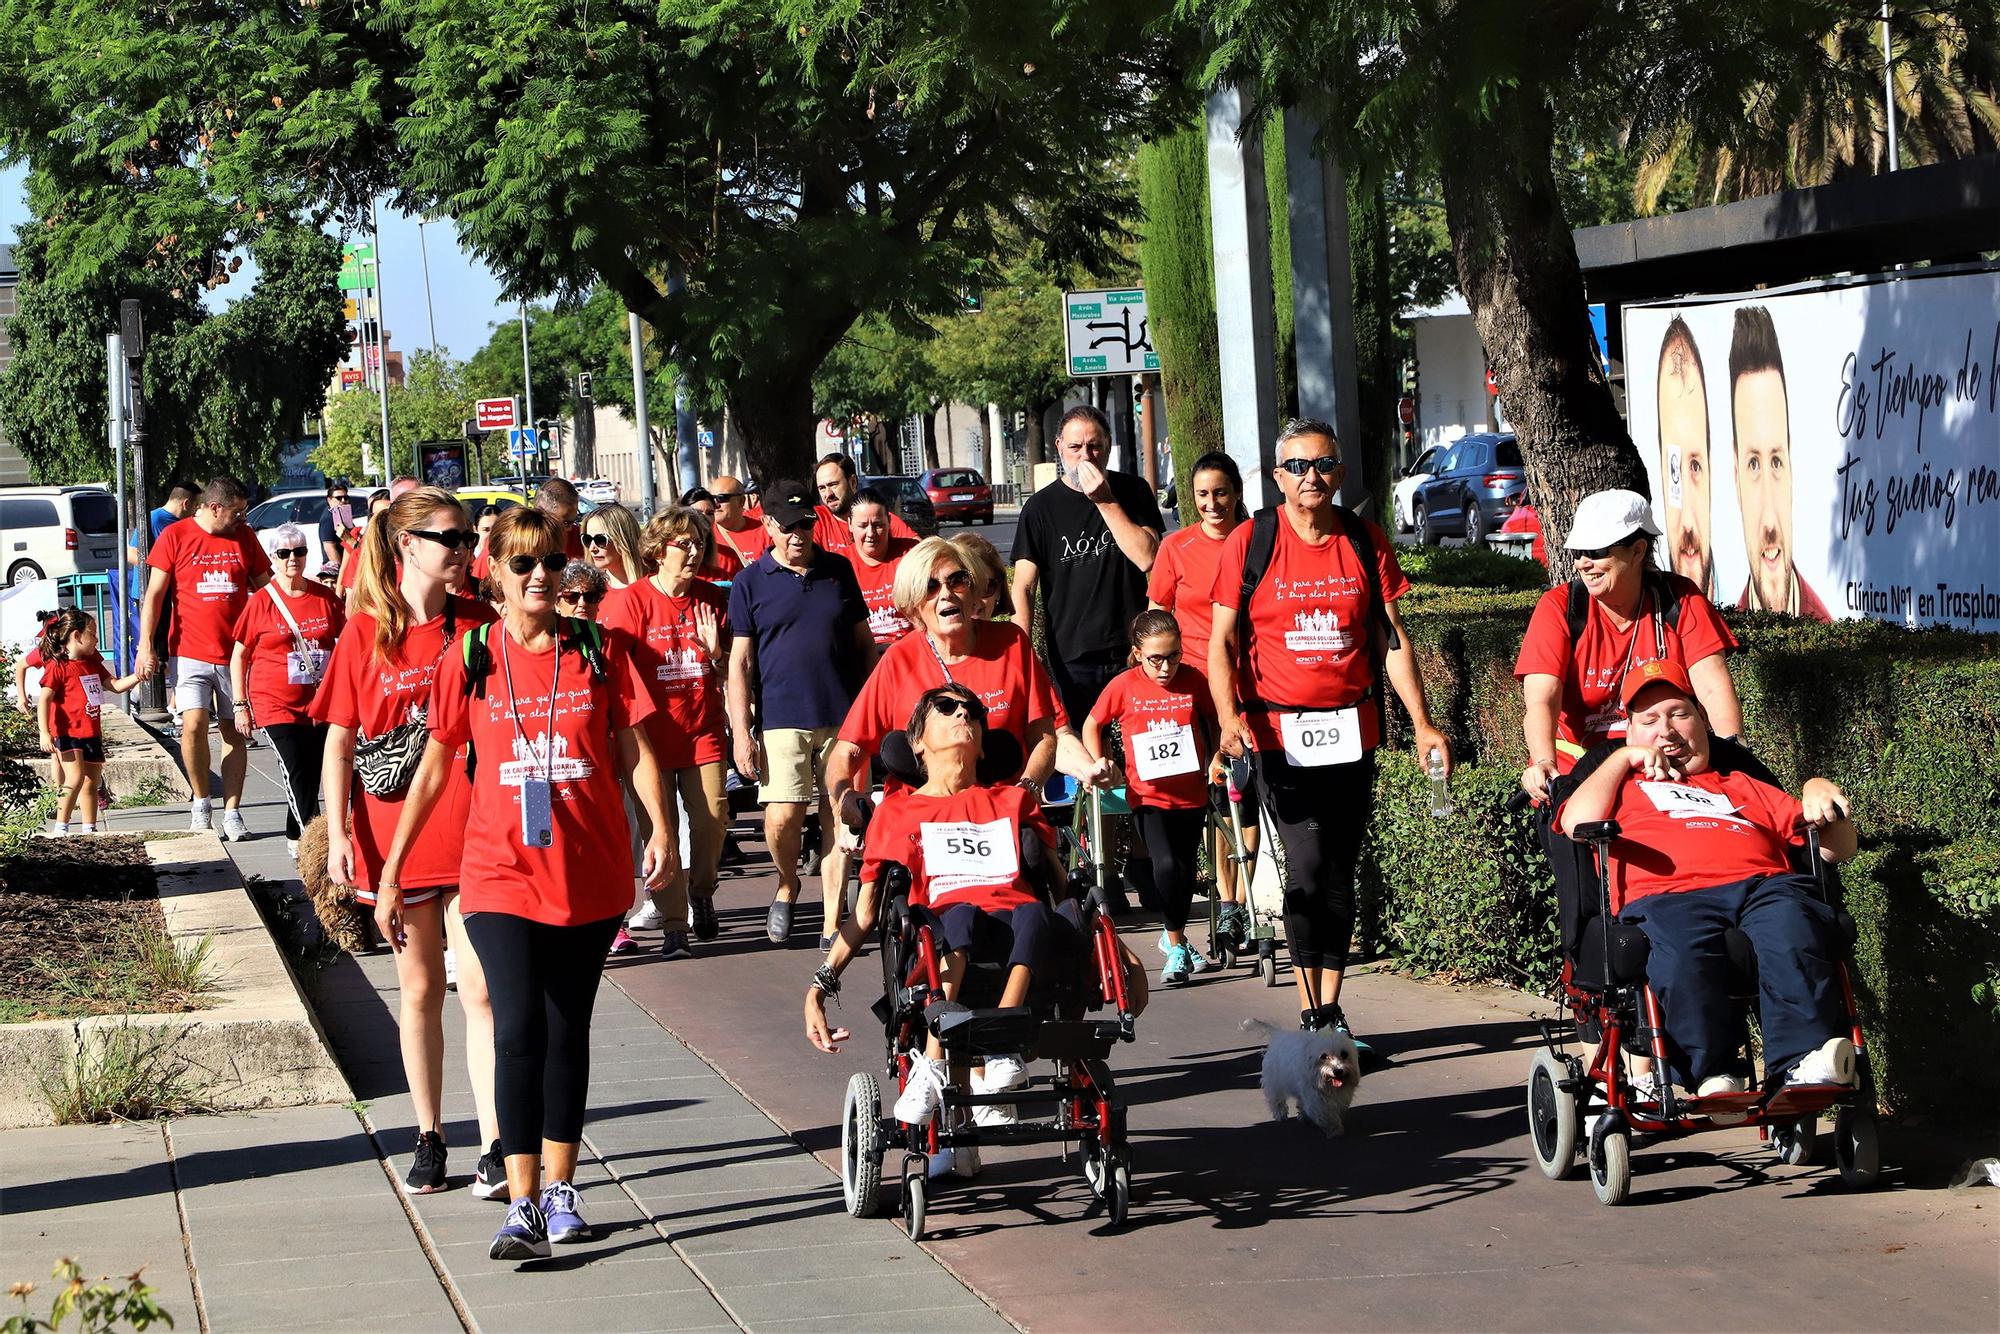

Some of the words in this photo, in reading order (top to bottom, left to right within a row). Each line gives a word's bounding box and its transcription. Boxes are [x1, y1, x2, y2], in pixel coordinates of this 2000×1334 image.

[1837, 351, 1871, 438] Es
[1956, 328, 1982, 402] de
[1887, 462, 1960, 535] sueños
[1846, 581, 1888, 613] Clínica
[1918, 594, 1935, 617] en
[299, 661, 320, 671] 62
[1301, 727, 1340, 748] 029
[1148, 741, 1181, 761] 182
[540, 763, 577, 771] SLIDARIA
[946, 838, 992, 857] 556
